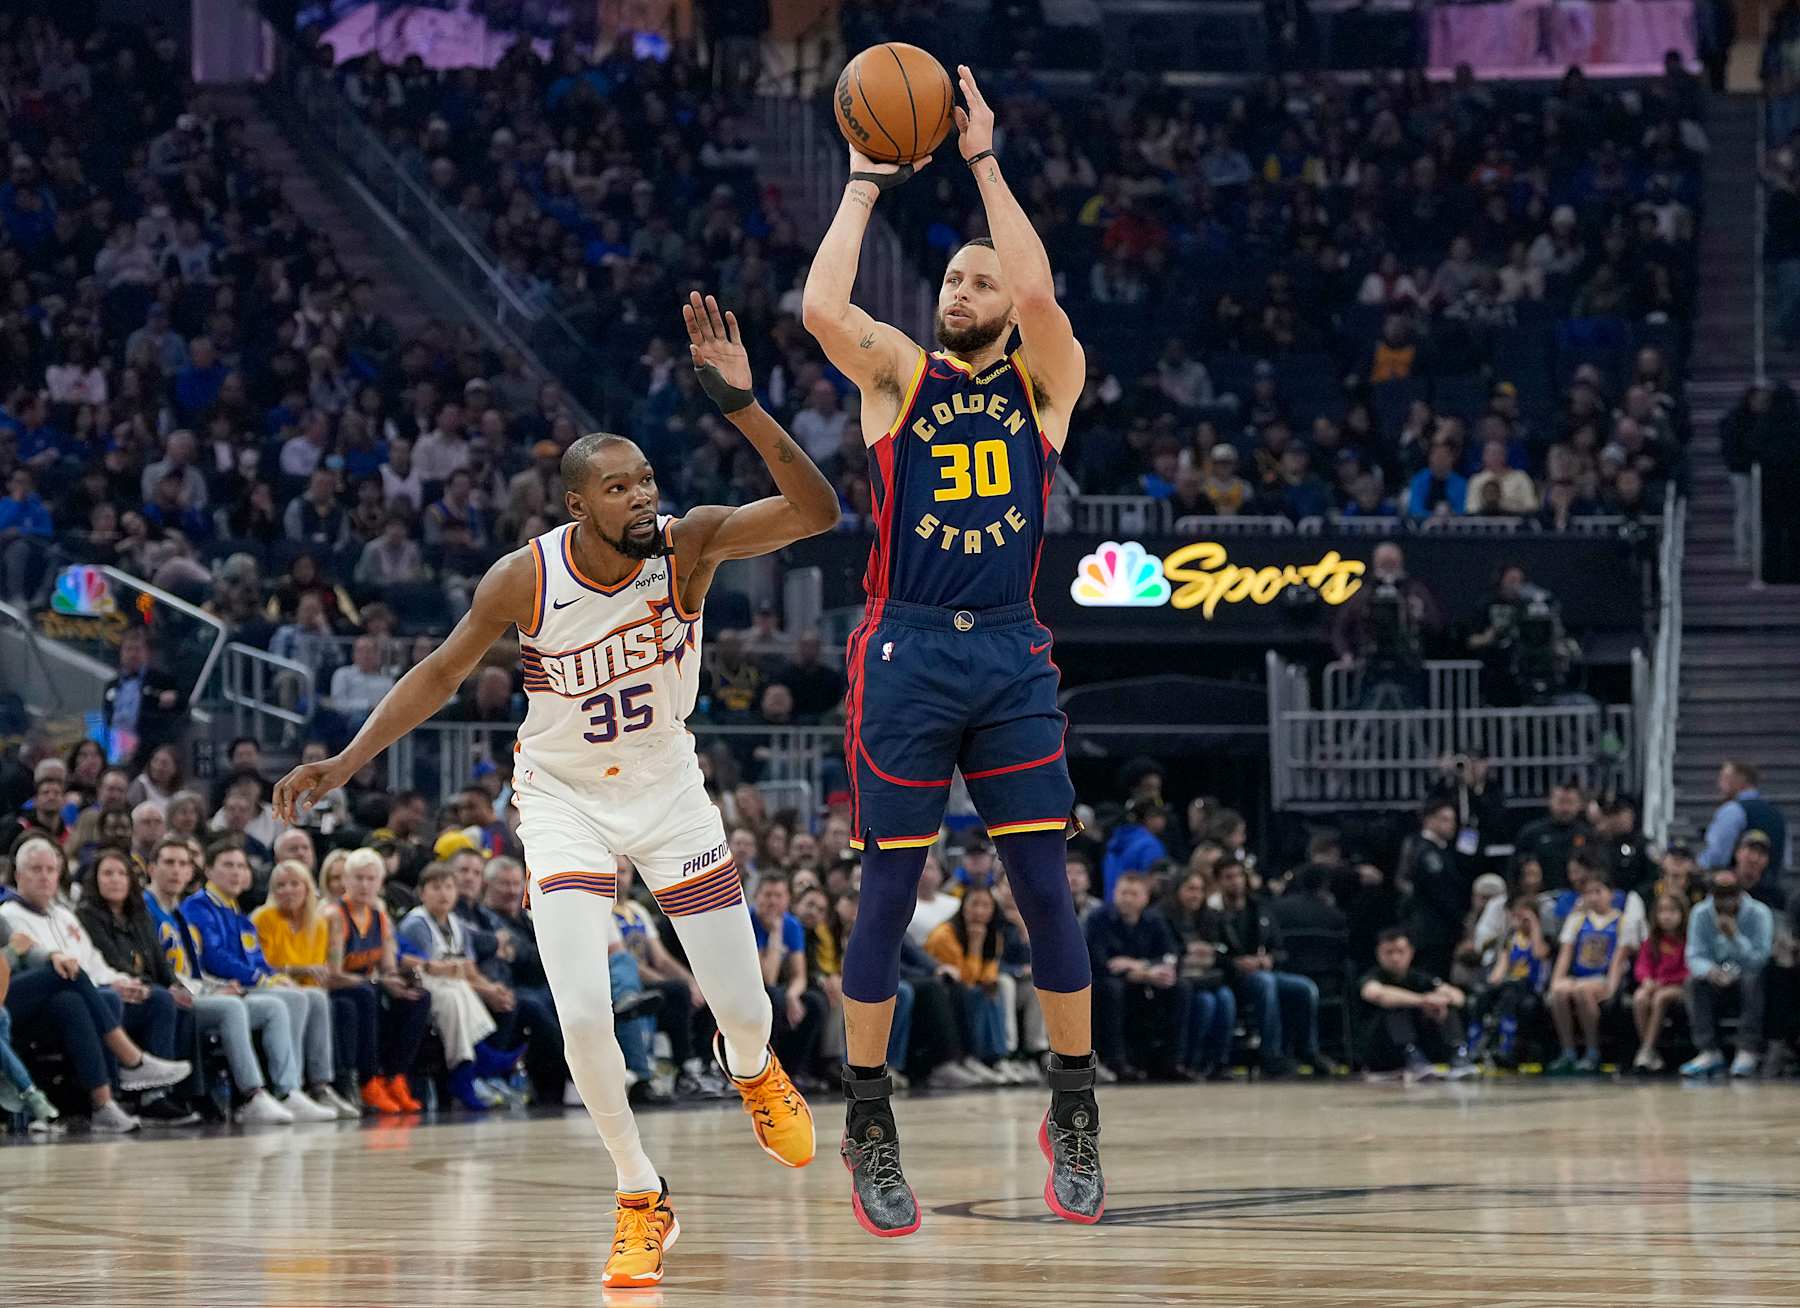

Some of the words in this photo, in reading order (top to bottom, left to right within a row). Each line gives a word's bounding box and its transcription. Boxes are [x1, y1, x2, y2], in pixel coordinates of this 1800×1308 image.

[975, 364, 1012, 385] Rakuten
[912, 393, 1027, 442] GOLDEN
[931, 439, 1012, 502] 30
[914, 505, 1027, 554] STATE
[635, 570, 666, 589] PayPal
[540, 623, 658, 696] SUNS
[581, 683, 654, 744] 35
